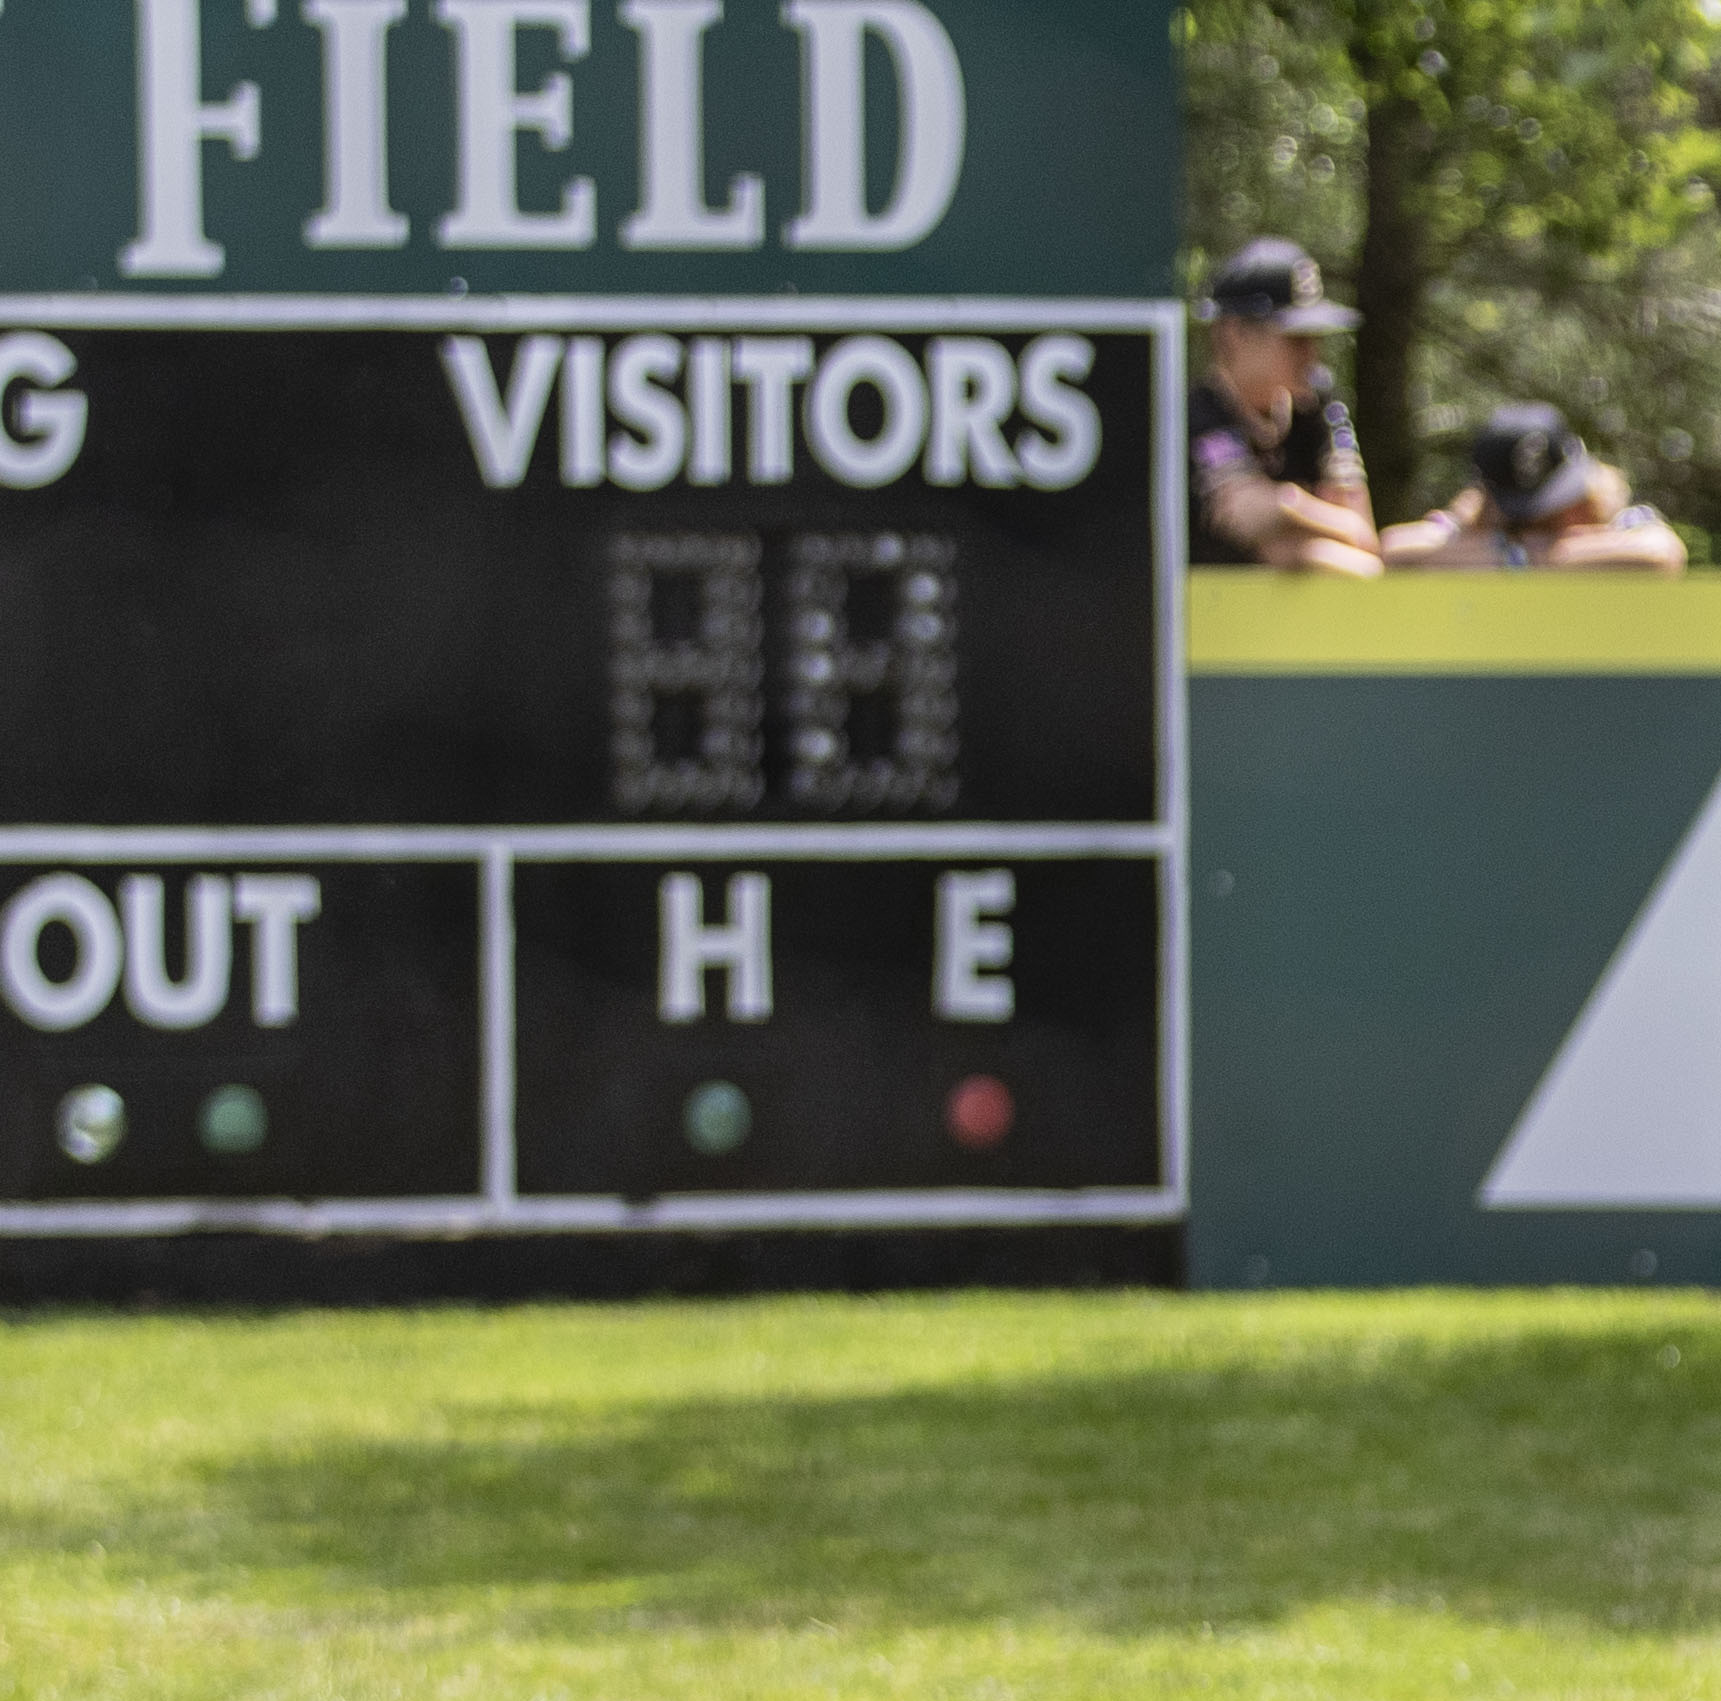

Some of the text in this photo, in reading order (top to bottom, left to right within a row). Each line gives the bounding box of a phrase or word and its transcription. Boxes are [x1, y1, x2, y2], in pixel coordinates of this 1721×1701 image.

[117, 0, 968, 280] FIELD
[443, 333, 1103, 489] VISITORS
[4, 872, 321, 1030] OUT
[657, 870, 773, 1024] H
[932, 870, 1015, 1023] E
